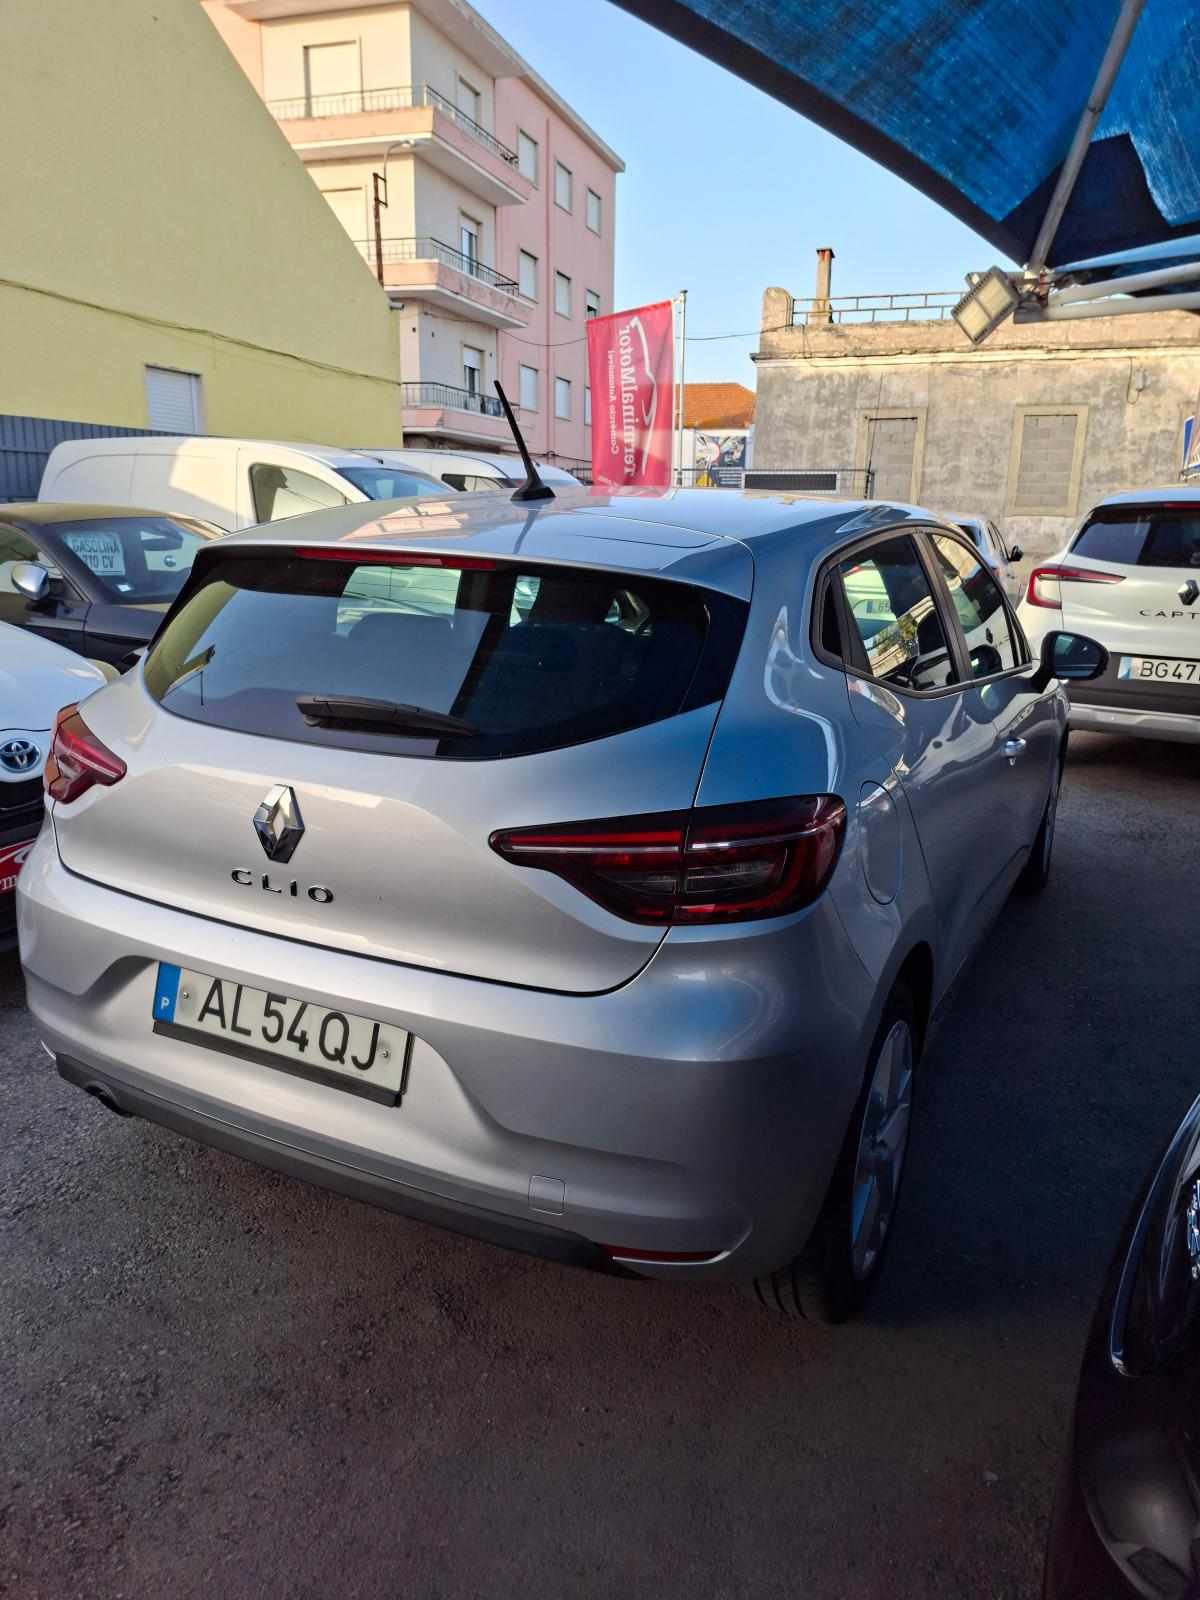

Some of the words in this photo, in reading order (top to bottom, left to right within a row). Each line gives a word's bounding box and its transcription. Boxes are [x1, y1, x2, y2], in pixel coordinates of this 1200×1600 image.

[71, 538, 121, 554] GASOLINA
[102, 554, 114, 569] CV
[1139, 610, 1200, 620] CAPT
[230, 868, 334, 904] CLIO
[160, 996, 171, 1010] P
